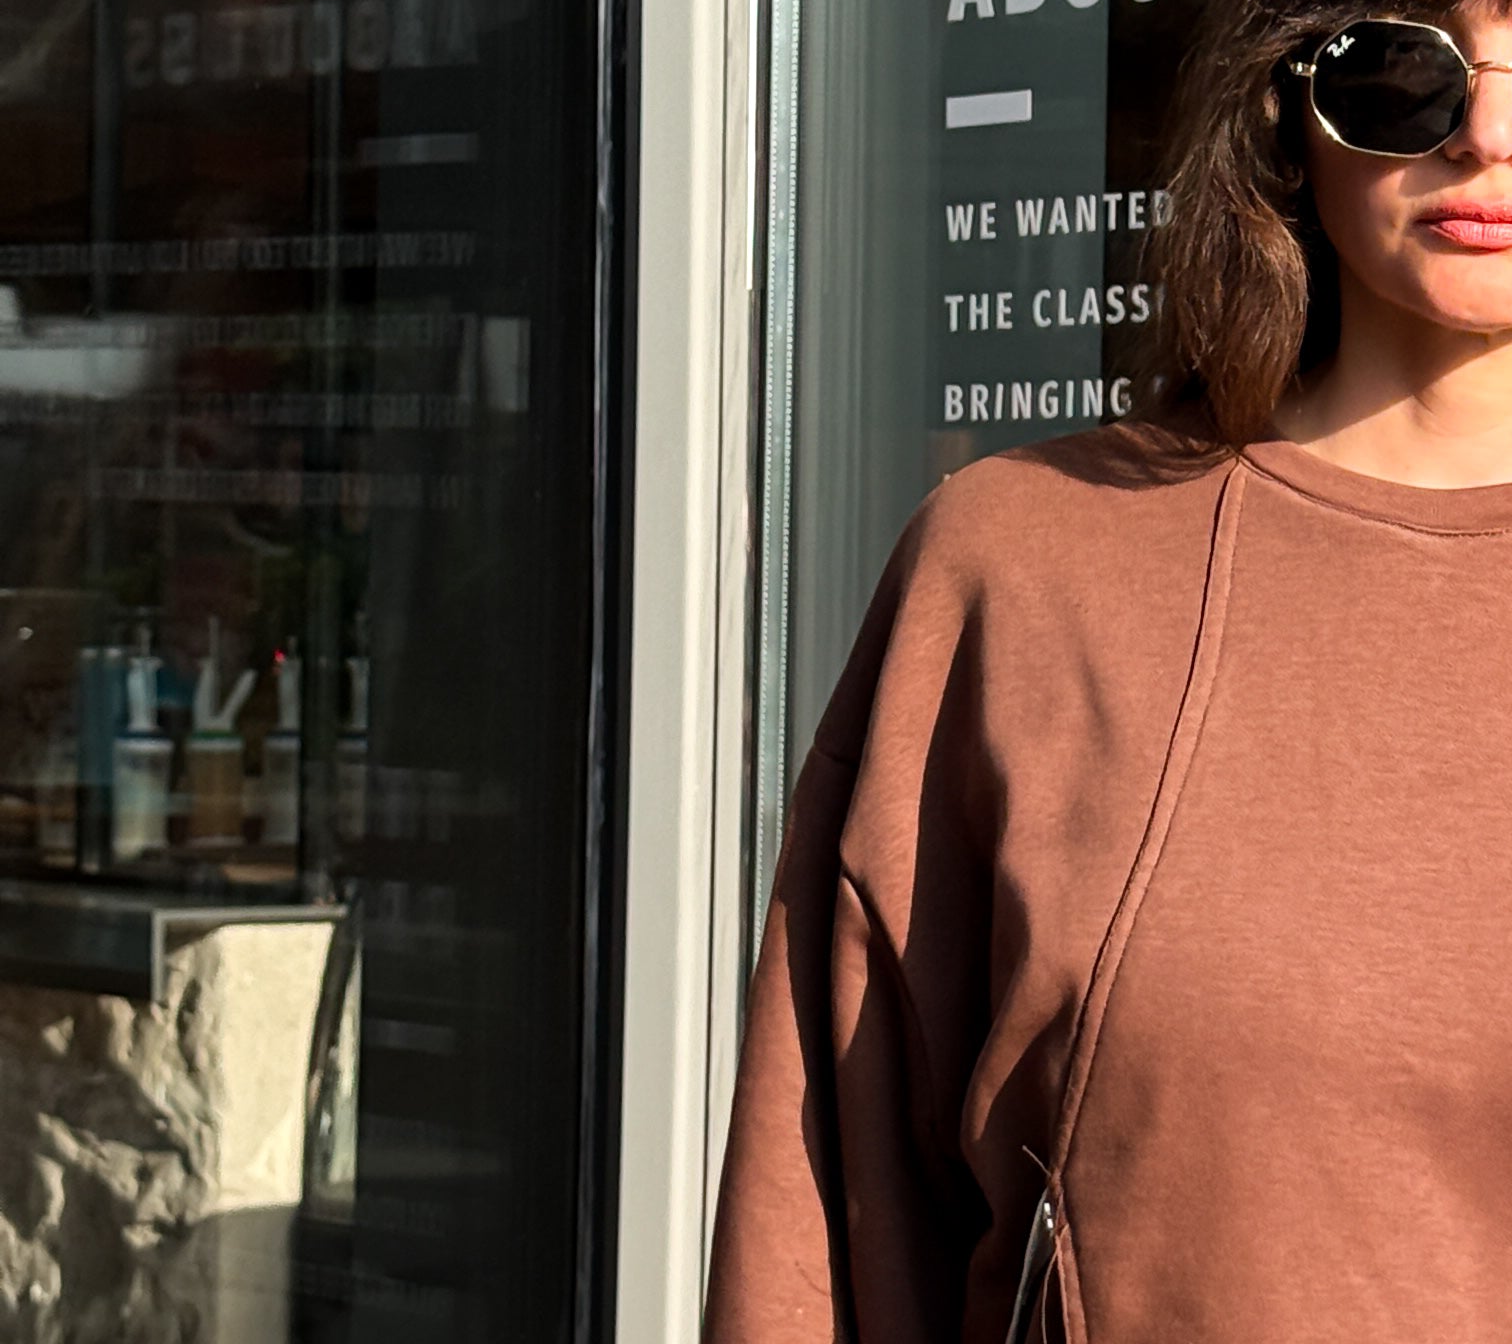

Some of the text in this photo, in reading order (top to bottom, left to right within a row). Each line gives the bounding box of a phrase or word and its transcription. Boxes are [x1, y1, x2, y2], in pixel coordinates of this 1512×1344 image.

[945, 202, 998, 243] WE
[943, 283, 1151, 332] THE CLASS
[943, 376, 1133, 423] BRINGING
